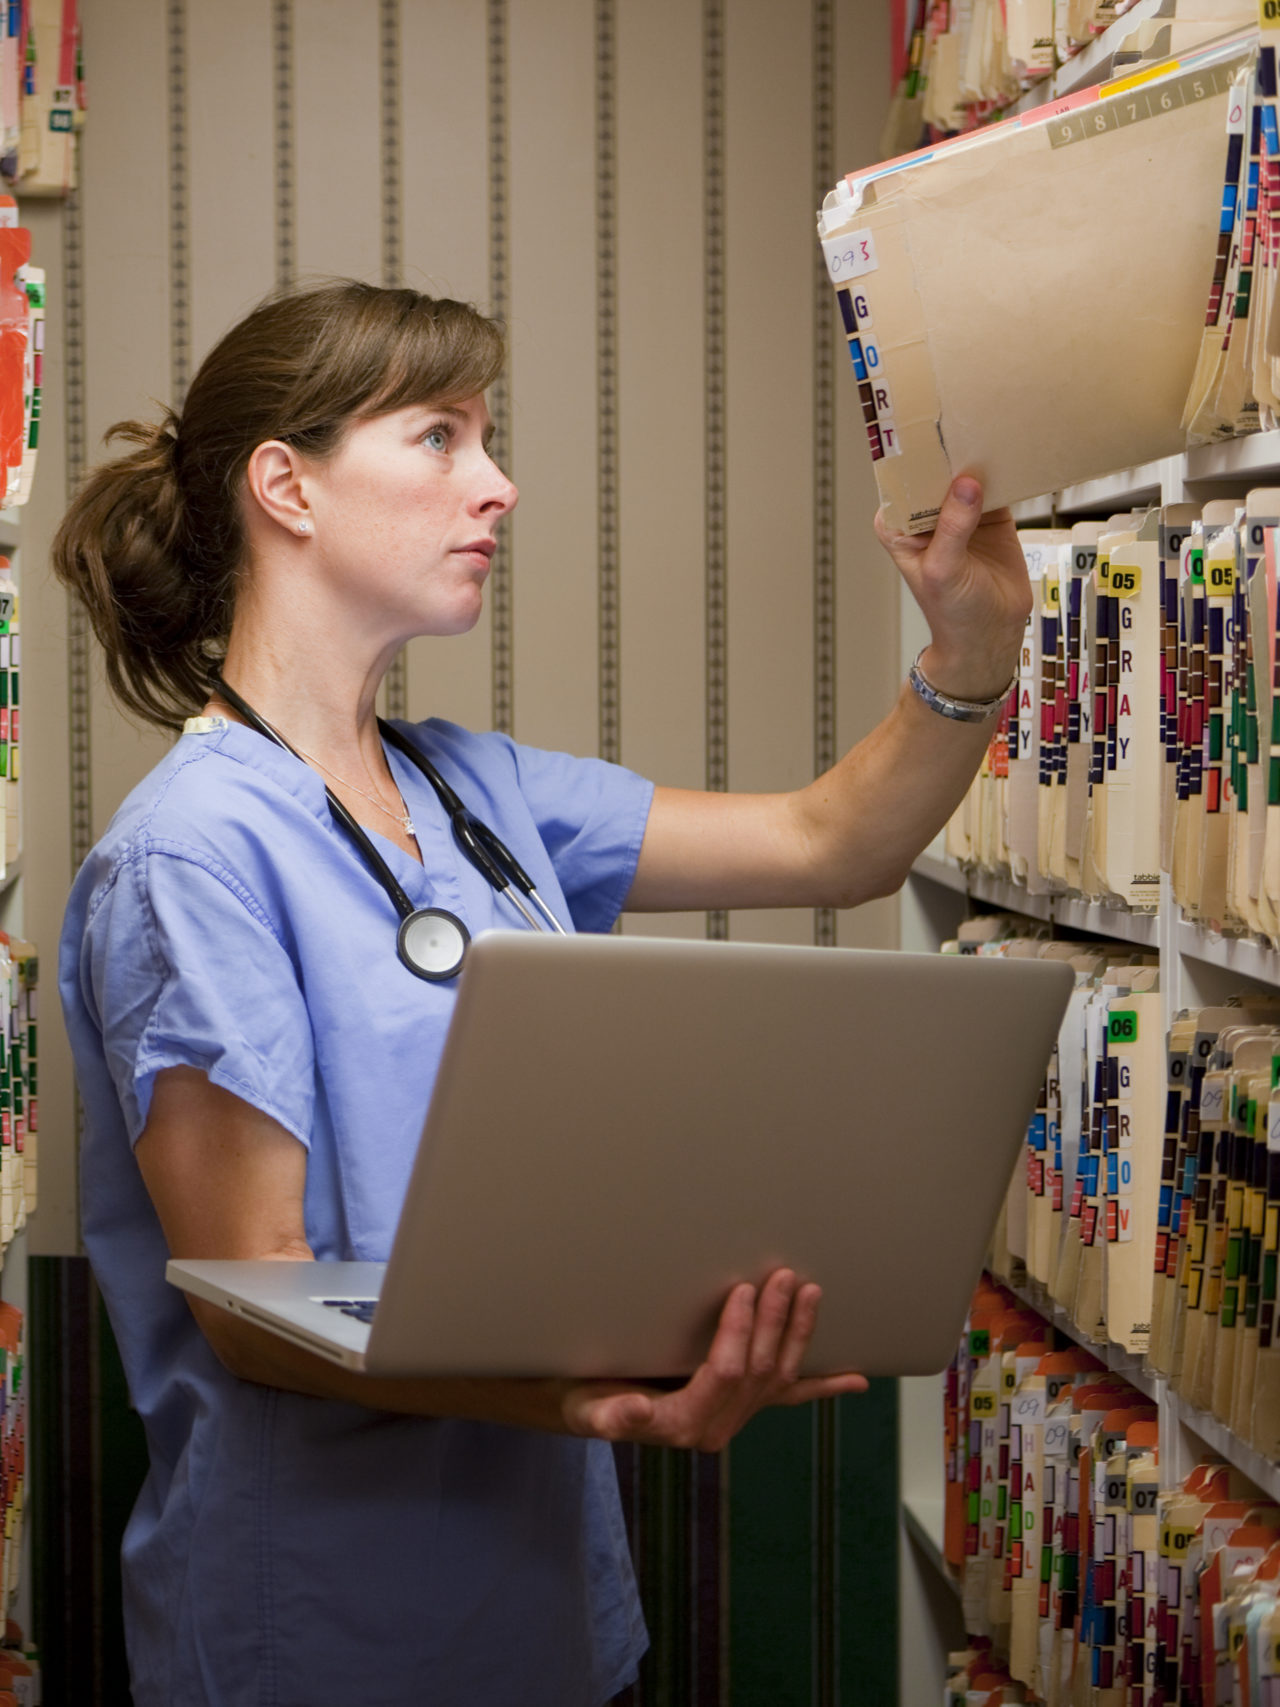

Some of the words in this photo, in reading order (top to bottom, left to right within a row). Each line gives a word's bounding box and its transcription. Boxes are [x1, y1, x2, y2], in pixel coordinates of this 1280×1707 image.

[1061, 125, 1073, 142] 9
[1094, 114, 1107, 131] 8
[1127, 103, 1138, 120] 7
[1160, 92, 1172, 109] 6
[1193, 81, 1205, 99] 5
[831, 240, 870, 272] 093
[1075, 552, 1097, 570] 07
[1112, 572, 1135, 590] 05
[1211, 567, 1233, 586] 05
[1120, 607, 1133, 760] GRAY
[1111, 1018, 1133, 1037] 06
[1120, 1065, 1131, 1232] GROV
[974, 1396, 993, 1410] 05
[1024, 1433, 1035, 1570] HADL
[1136, 1490, 1157, 1509] 07
